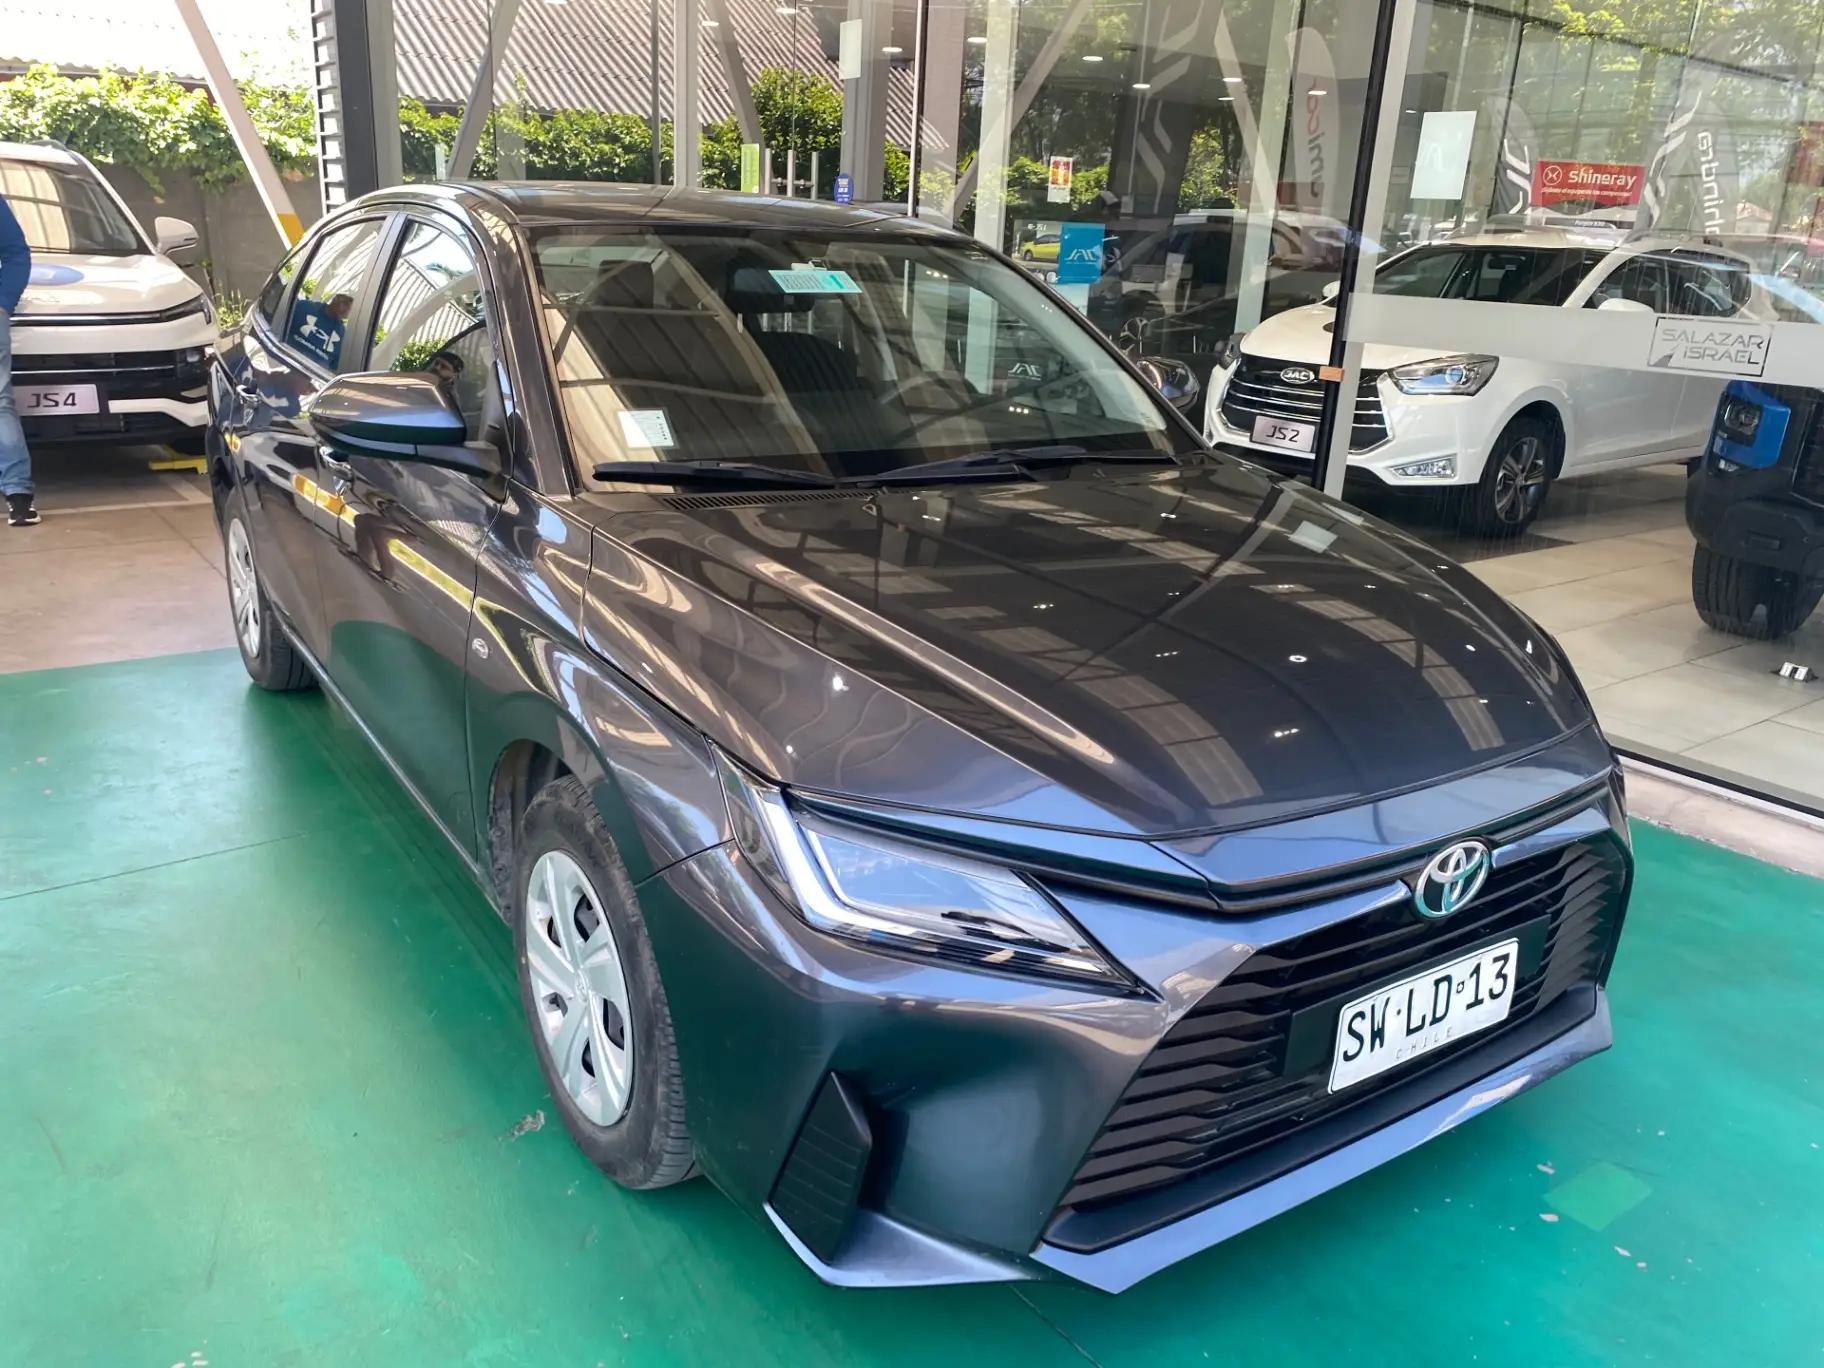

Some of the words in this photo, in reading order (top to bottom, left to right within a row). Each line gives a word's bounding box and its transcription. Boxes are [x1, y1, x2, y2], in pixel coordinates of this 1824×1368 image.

[1567, 165, 1637, 190] Shineray
[1661, 328, 1764, 349] SALAZAR
[1683, 346, 1760, 365] ISRAEL
[1283, 369, 1309, 380] JAC
[27, 392, 77, 409] JS4
[1265, 424, 1300, 443] JS2
